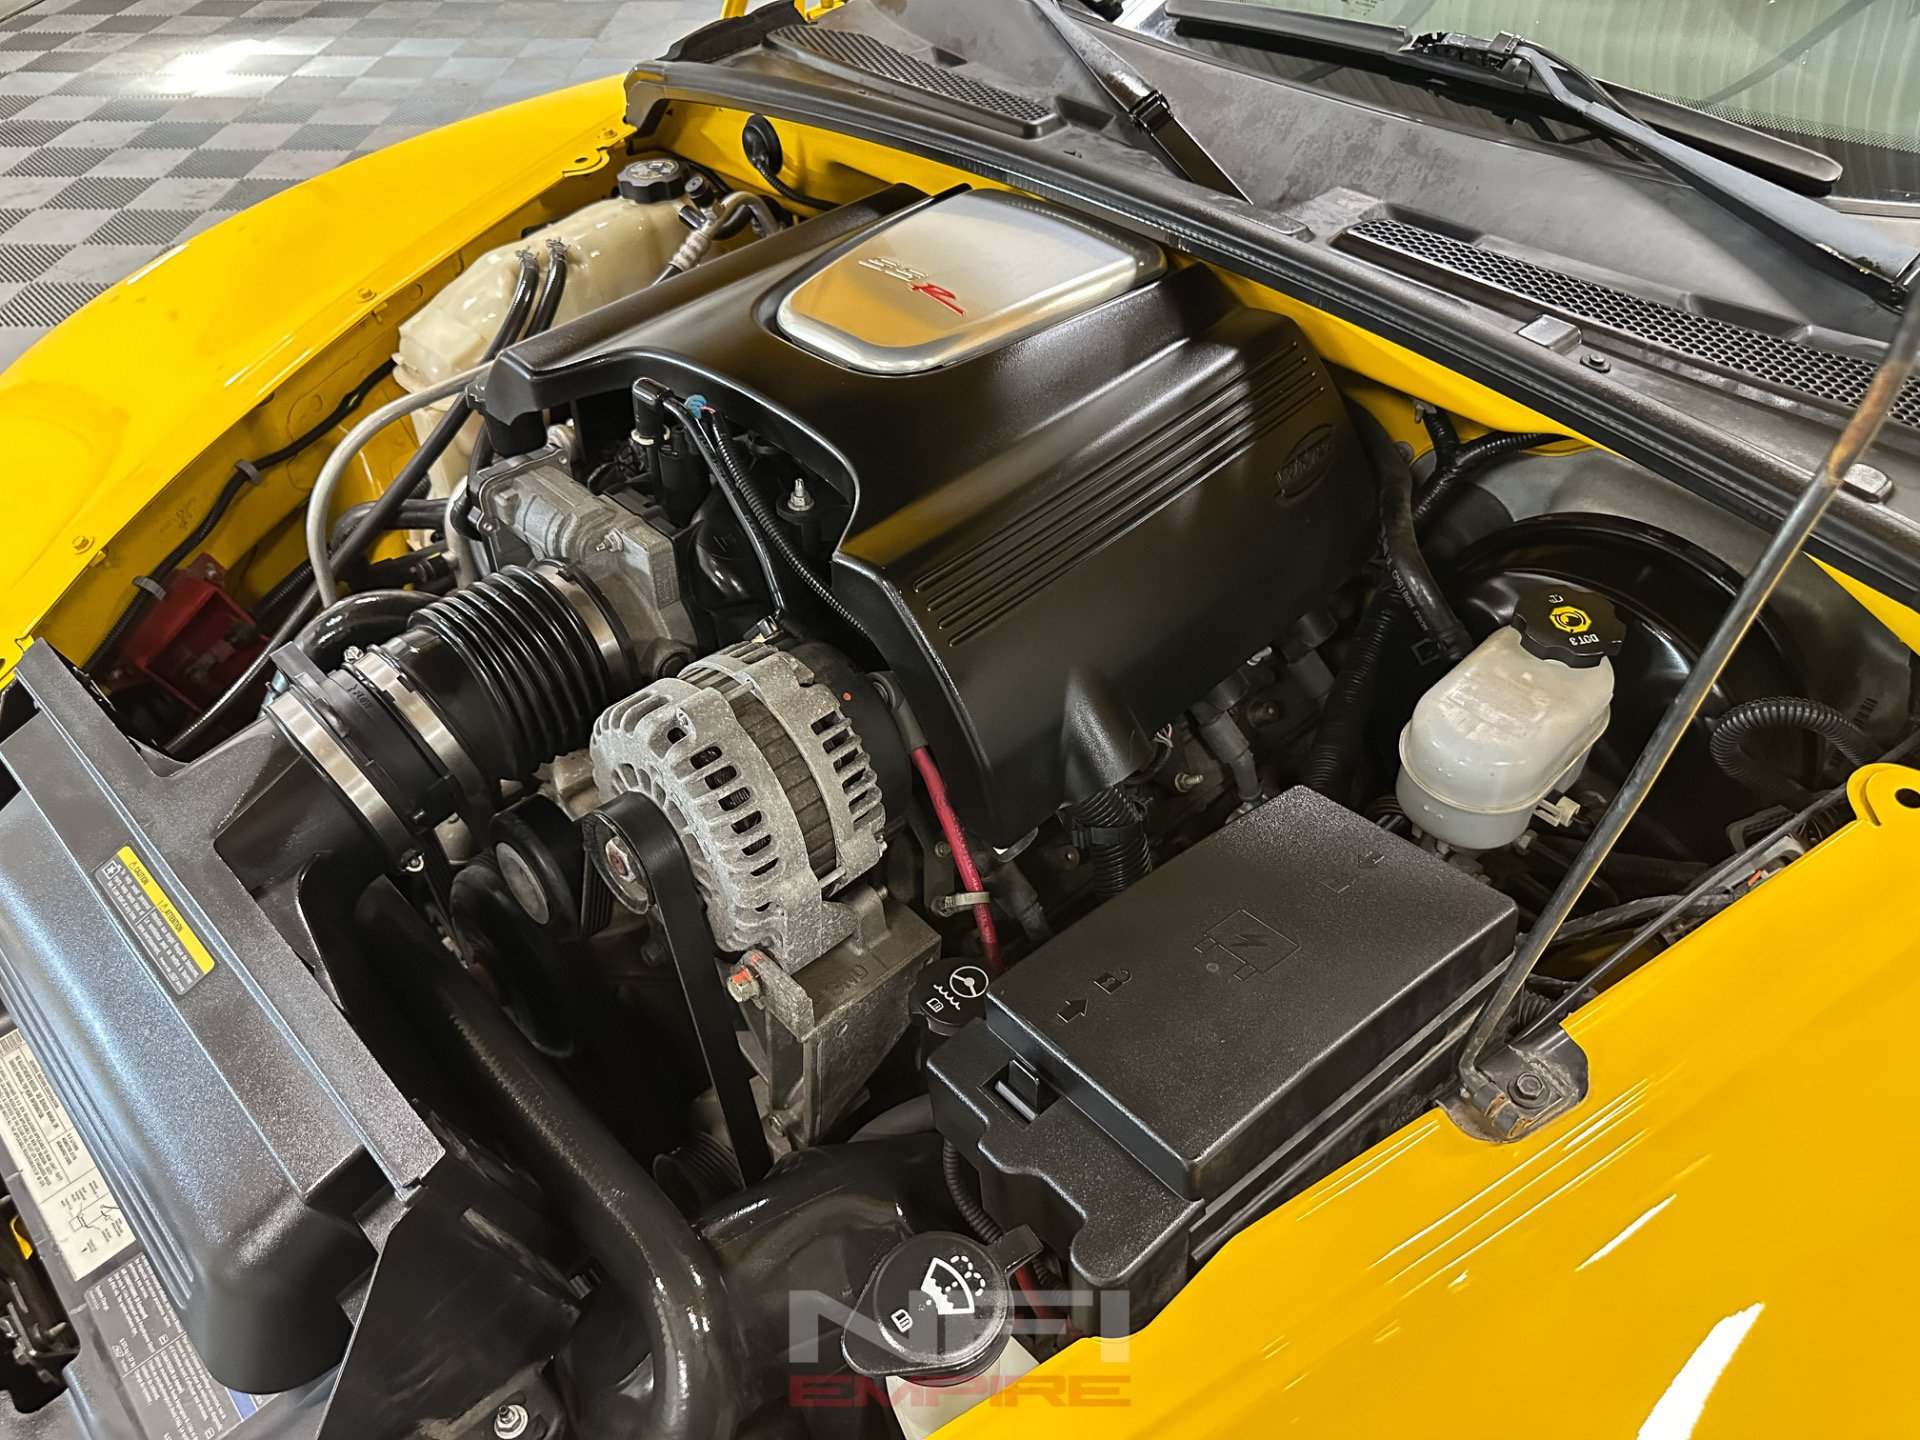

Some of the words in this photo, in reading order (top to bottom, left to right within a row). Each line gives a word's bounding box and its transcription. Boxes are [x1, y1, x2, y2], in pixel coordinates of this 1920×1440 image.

[858, 256, 965, 316] SSR
[1578, 633, 1600, 645] DOT
[133, 866, 149, 885] CAUTION
[165, 909, 183, 932] ATTENTION
